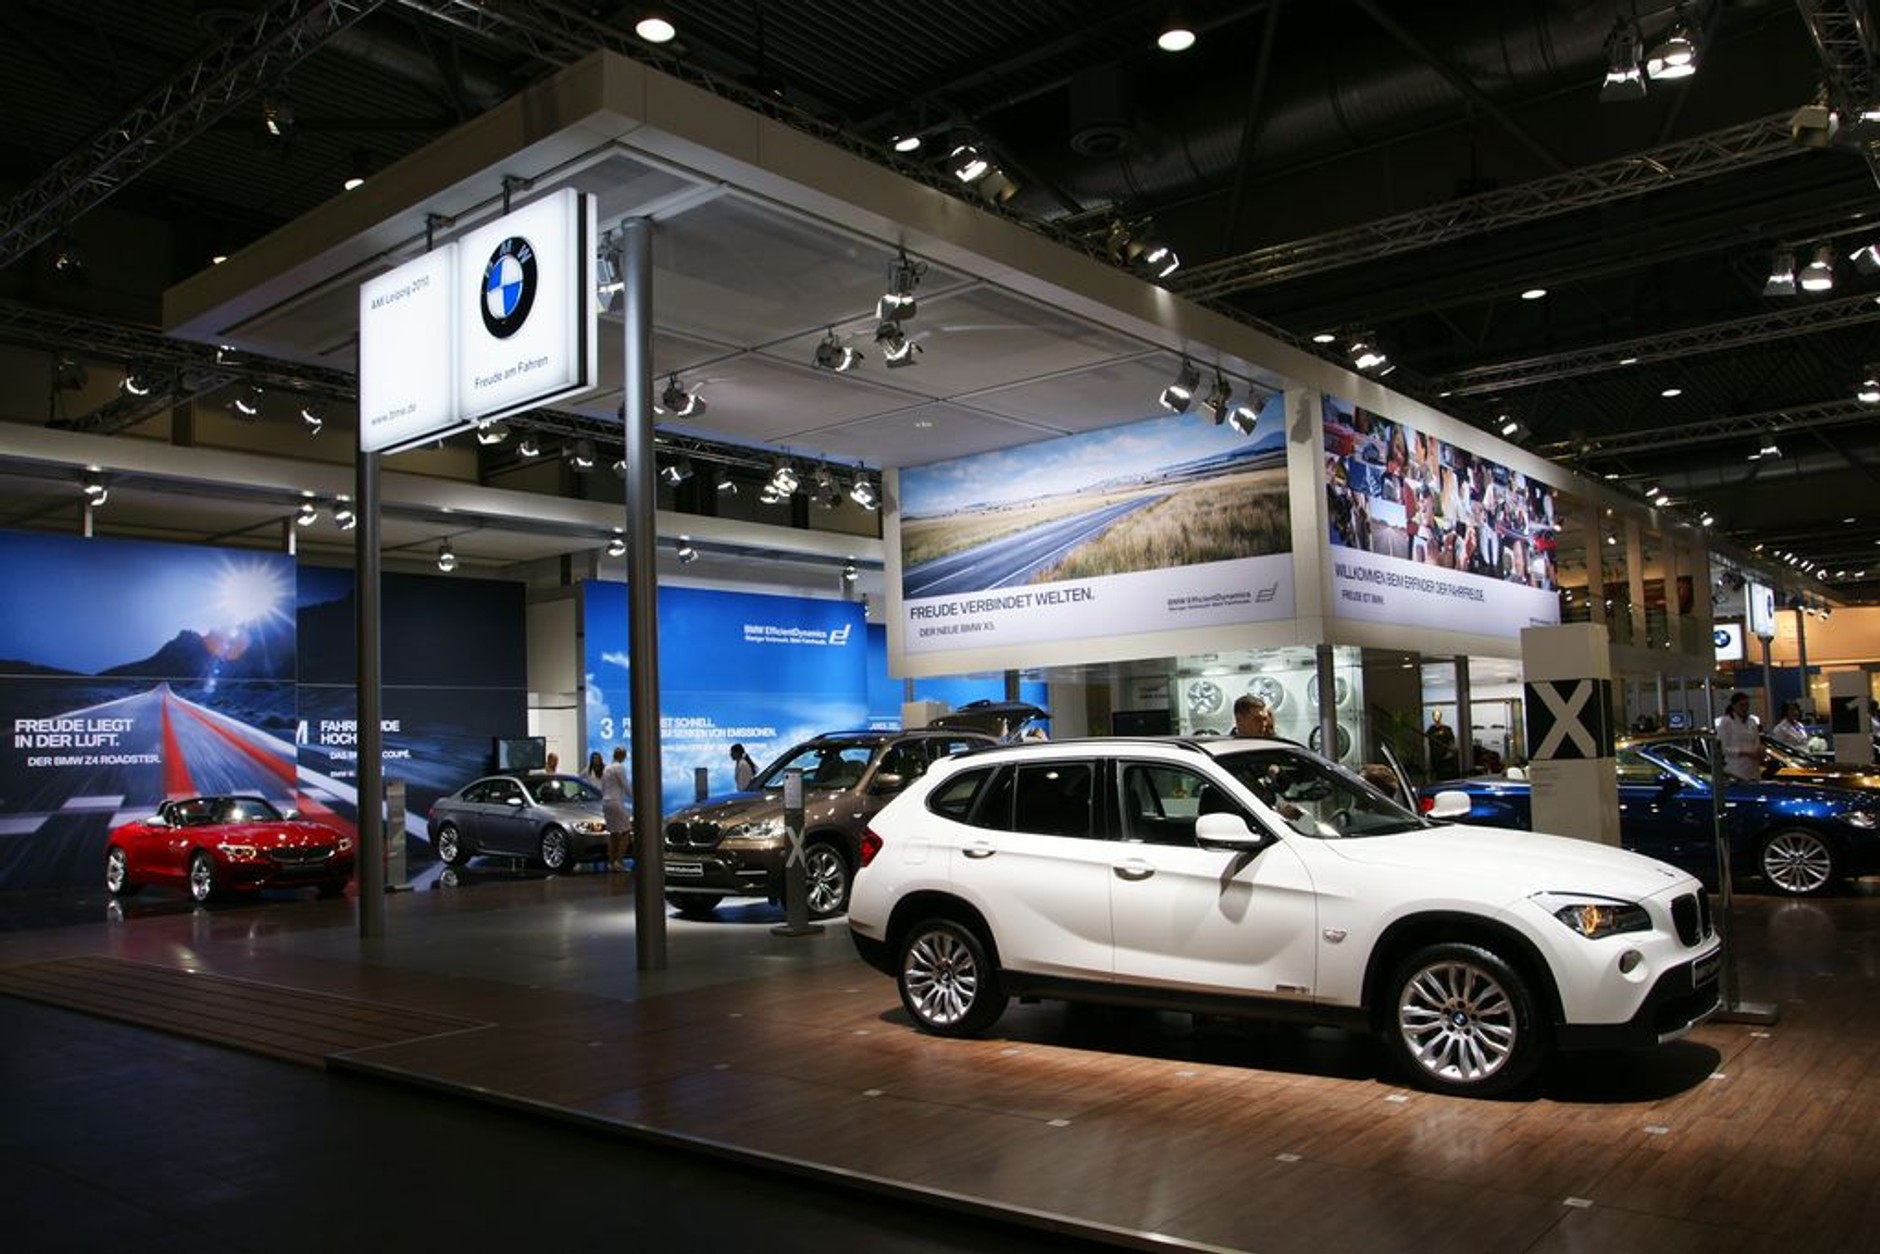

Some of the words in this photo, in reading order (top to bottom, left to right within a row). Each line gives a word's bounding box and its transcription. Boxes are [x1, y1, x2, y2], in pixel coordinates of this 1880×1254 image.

[475, 372, 502, 390] Freude
[503, 366, 517, 379] am
[517, 356, 548, 374] Fahren
[1334, 563, 1385, 585] WILLKOMMEN
[910, 602, 958, 619] FREUDE
[960, 594, 1032, 613] VERBINDET
[1034, 587, 1095, 607] WELTEN.
[919, 627, 936, 638] DER
[936, 625, 960, 636] NEUE
[961, 623, 982, 634] BMW
[15, 719, 85, 733] FREUDE
[87, 719, 134, 732] LIEGT
[600, 718, 614, 740] 3
[1530, 679, 1597, 759] X
[15, 734, 33, 748] IN
[36, 734, 72, 748] DER
[75, 734, 120, 747] LUFT.
[27, 756, 53, 767] DER
[54, 756, 83, 766] BMW
[84, 755, 99, 765] Z4
[101, 754, 161, 765] ROADSTER.
[786, 826, 806, 868] X
